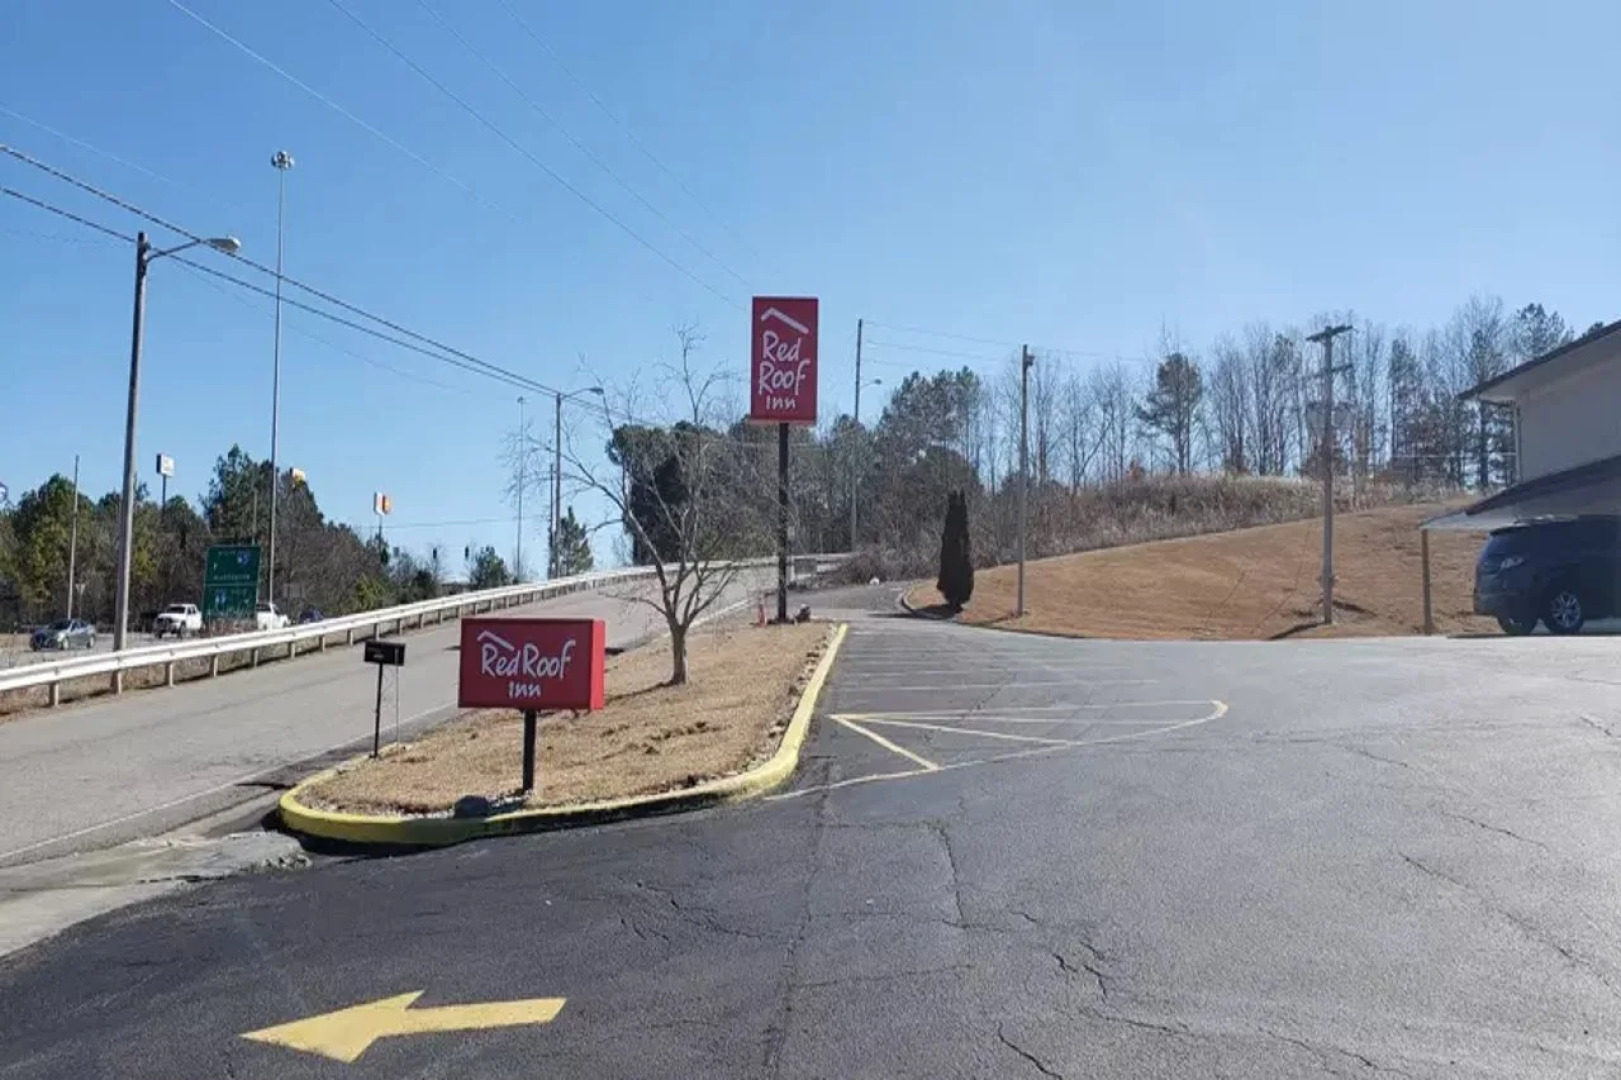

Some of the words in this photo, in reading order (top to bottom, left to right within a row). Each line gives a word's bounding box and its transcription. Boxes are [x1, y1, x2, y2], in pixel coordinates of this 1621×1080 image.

[762, 330, 802, 362] Red
[758, 360, 811, 396] Roof
[481, 642, 521, 678] Red
[522, 639, 576, 680] Roof
